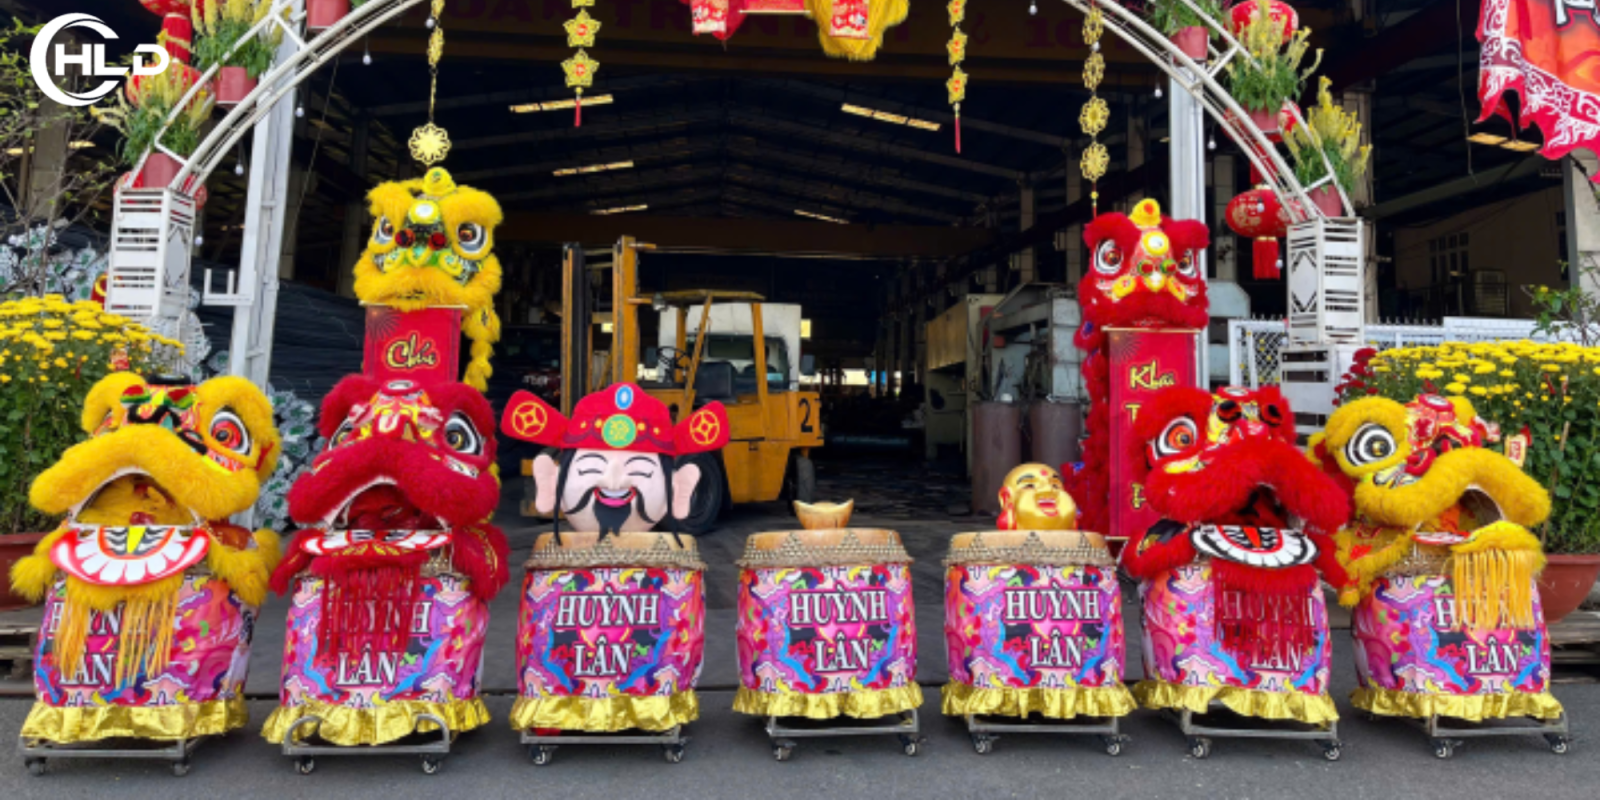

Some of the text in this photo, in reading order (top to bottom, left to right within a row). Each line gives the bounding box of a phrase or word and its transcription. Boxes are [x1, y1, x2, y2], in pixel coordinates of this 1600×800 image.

[1130, 360, 1175, 389] Khai
[798, 397, 813, 433] 2
[555, 586, 659, 626] HUỲNH
[789, 584, 888, 624] HUỲNH
[1005, 581, 1101, 620] HUỲNH
[335, 643, 402, 685] LÂN
[573, 635, 634, 676] LÂN
[814, 631, 870, 671] LÂN
[1030, 628, 1083, 667] LÂN
[1465, 636, 1520, 673] LÂN
